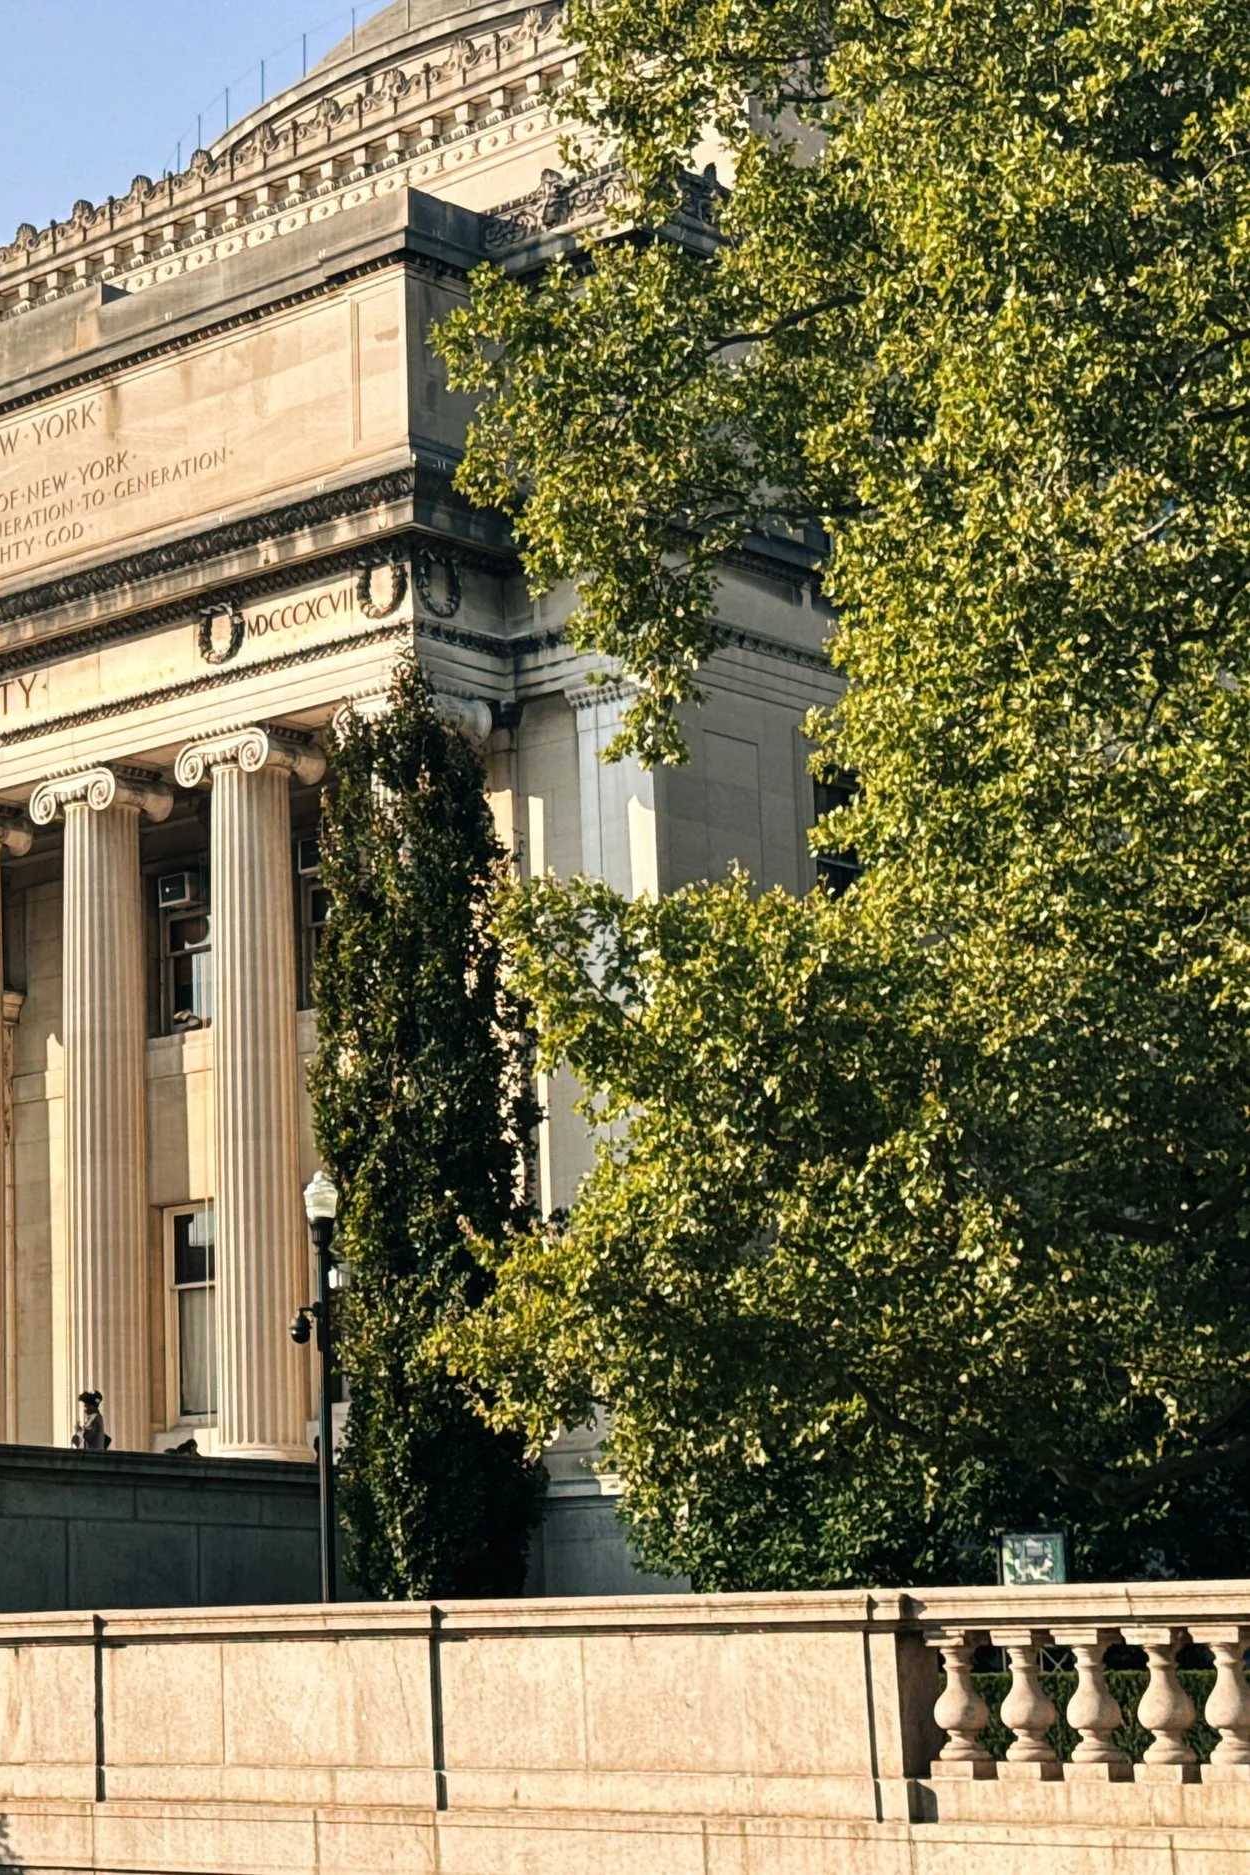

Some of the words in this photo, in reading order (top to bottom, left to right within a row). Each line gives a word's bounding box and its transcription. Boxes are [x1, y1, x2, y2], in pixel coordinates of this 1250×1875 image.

[32, 401, 96, 446] YORK
[27, 471, 68, 504] NEW
[78, 450, 129, 486] YORK
[82, 489, 105, 510] TO
[114, 446, 226, 499] GENERATION
[45, 522, 84, 548] GOD
[247, 587, 354, 640] MDCCCXCVII
